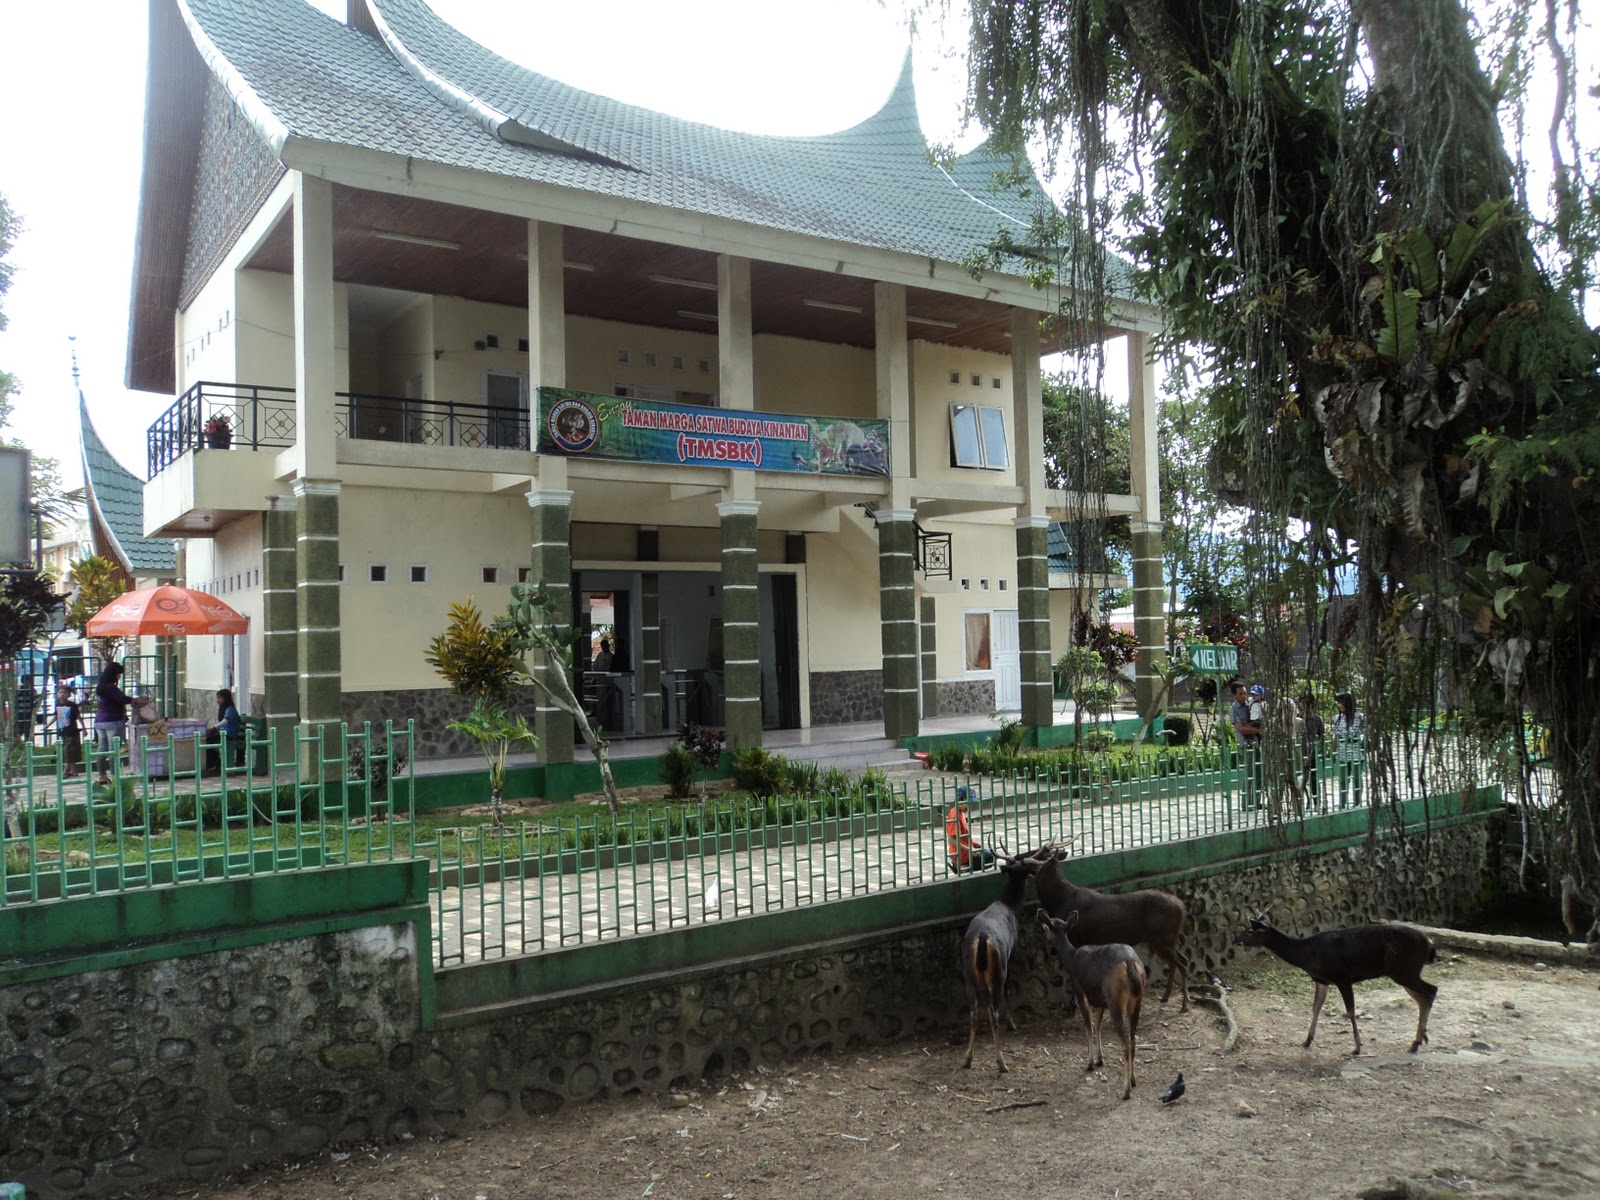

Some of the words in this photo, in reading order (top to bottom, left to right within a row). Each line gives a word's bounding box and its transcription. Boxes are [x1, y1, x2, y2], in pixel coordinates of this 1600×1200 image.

[622, 409, 658, 429] TAMAN
[659, 412, 695, 432] MARGA
[696, 415, 727, 434] SATWA
[728, 417, 762, 437] BUDAYA
[763, 420, 809, 441] KINANTAN
[677, 432, 762, 467] (TMSBK)
